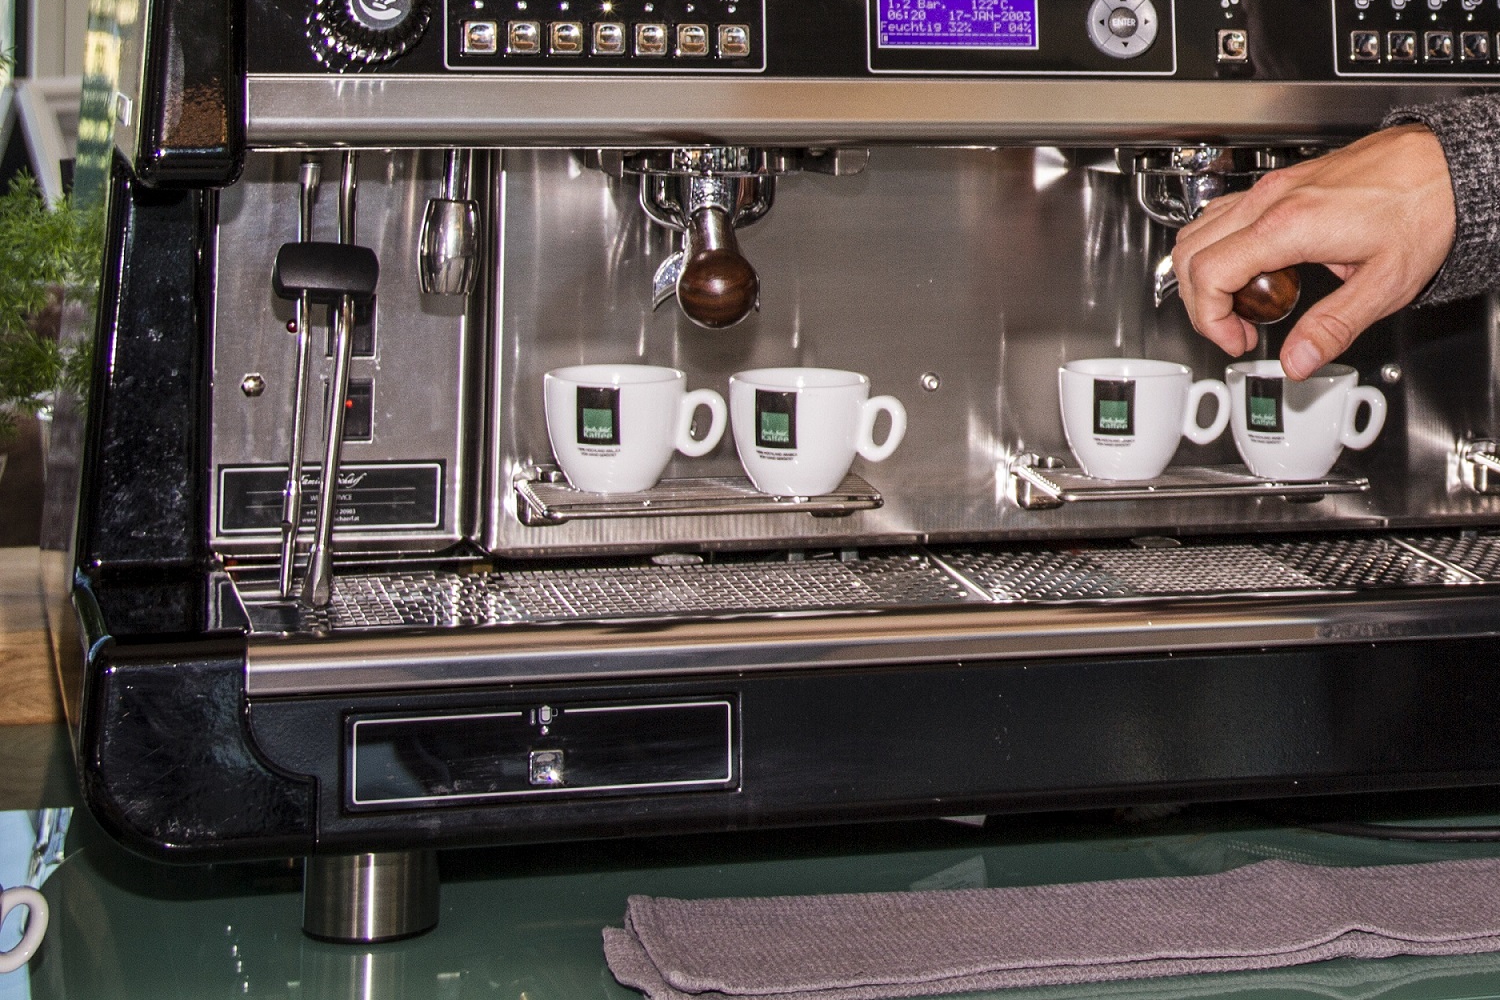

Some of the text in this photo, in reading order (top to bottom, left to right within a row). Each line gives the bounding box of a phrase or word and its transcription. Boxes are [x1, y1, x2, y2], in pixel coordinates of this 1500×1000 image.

[887, 10, 1032, 22] 06:20 17-JAN-2003
[1112, 17, 1137, 27] ENTER
[880, 21, 942, 33] Feuchtig
[948, 22, 972, 33] 32%
